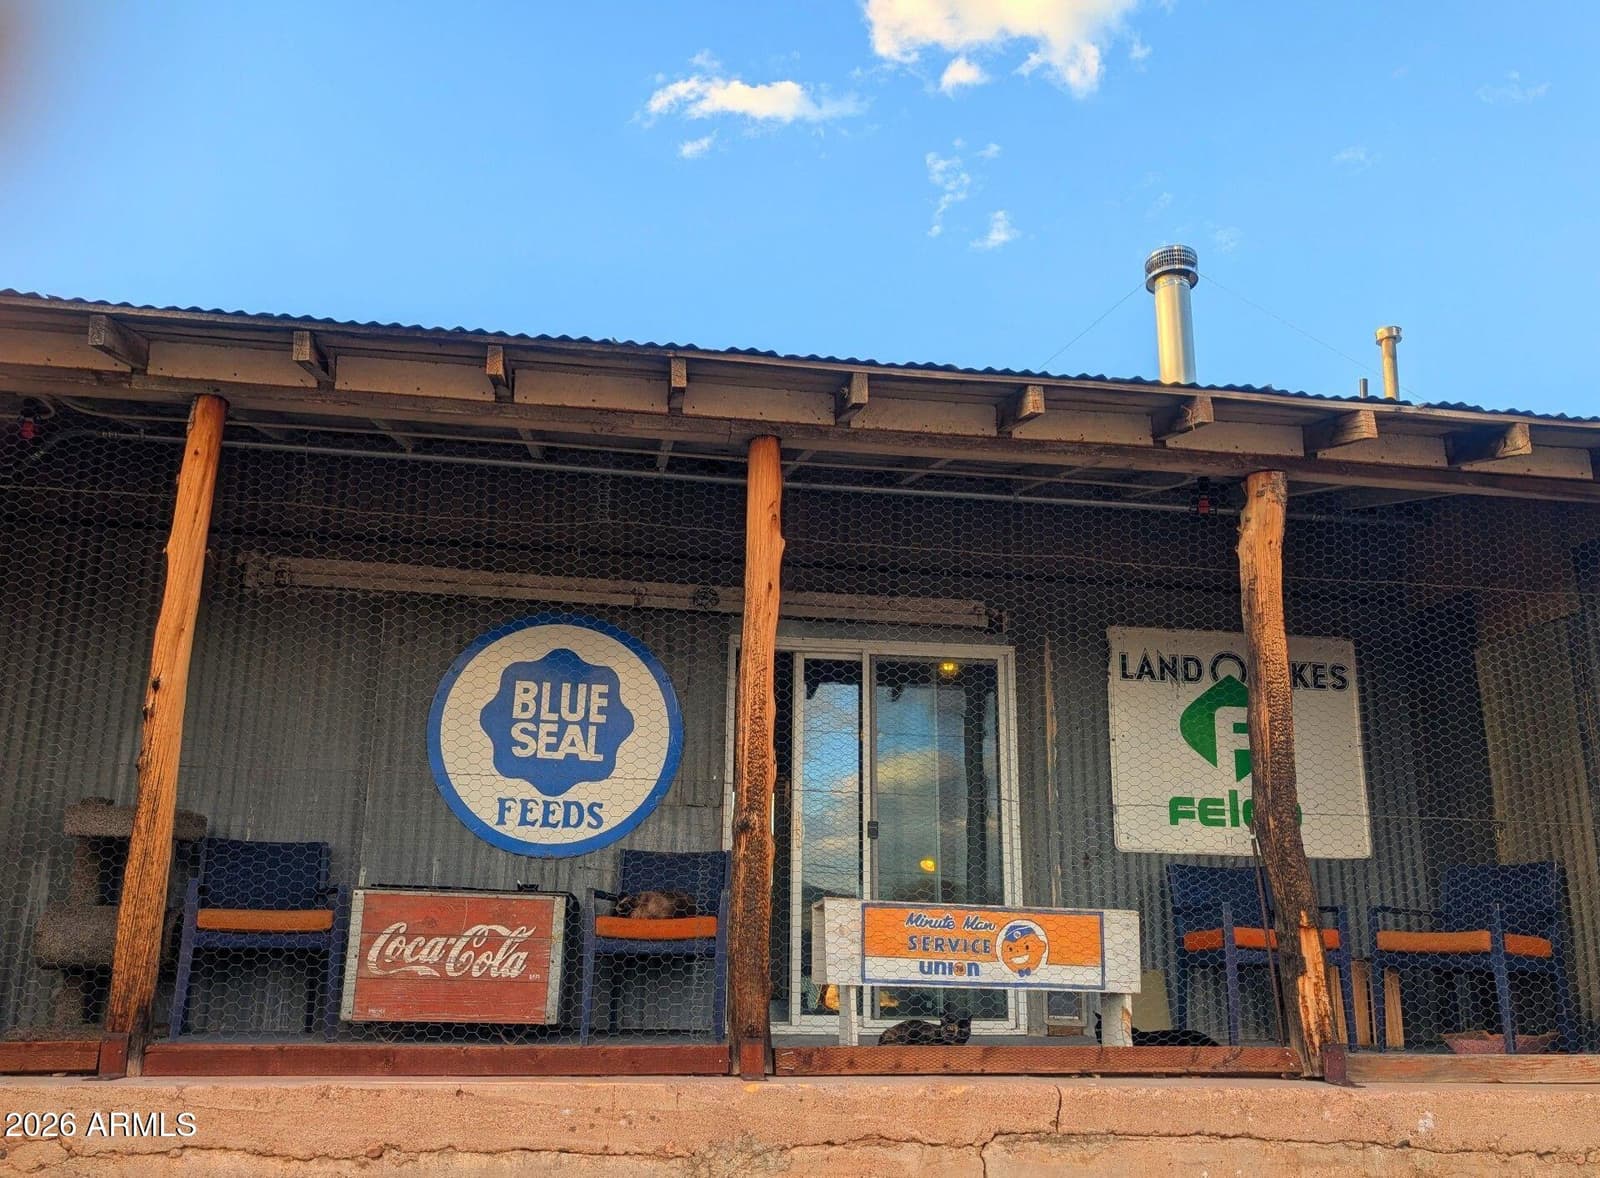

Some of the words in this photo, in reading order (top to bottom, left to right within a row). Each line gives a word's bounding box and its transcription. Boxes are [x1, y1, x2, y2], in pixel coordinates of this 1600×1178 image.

[1119, 653, 1203, 684] LAND
[1291, 661, 1350, 691] KES
[512, 680, 609, 723] BLUE
[510, 722, 603, 762] SEAL
[495, 797, 604, 829] FEEDS
[905, 912, 956, 930] Minute
[962, 915, 997, 931] Man
[367, 921, 536, 977] Coca-Cola
[907, 935, 992, 955] SERVICE
